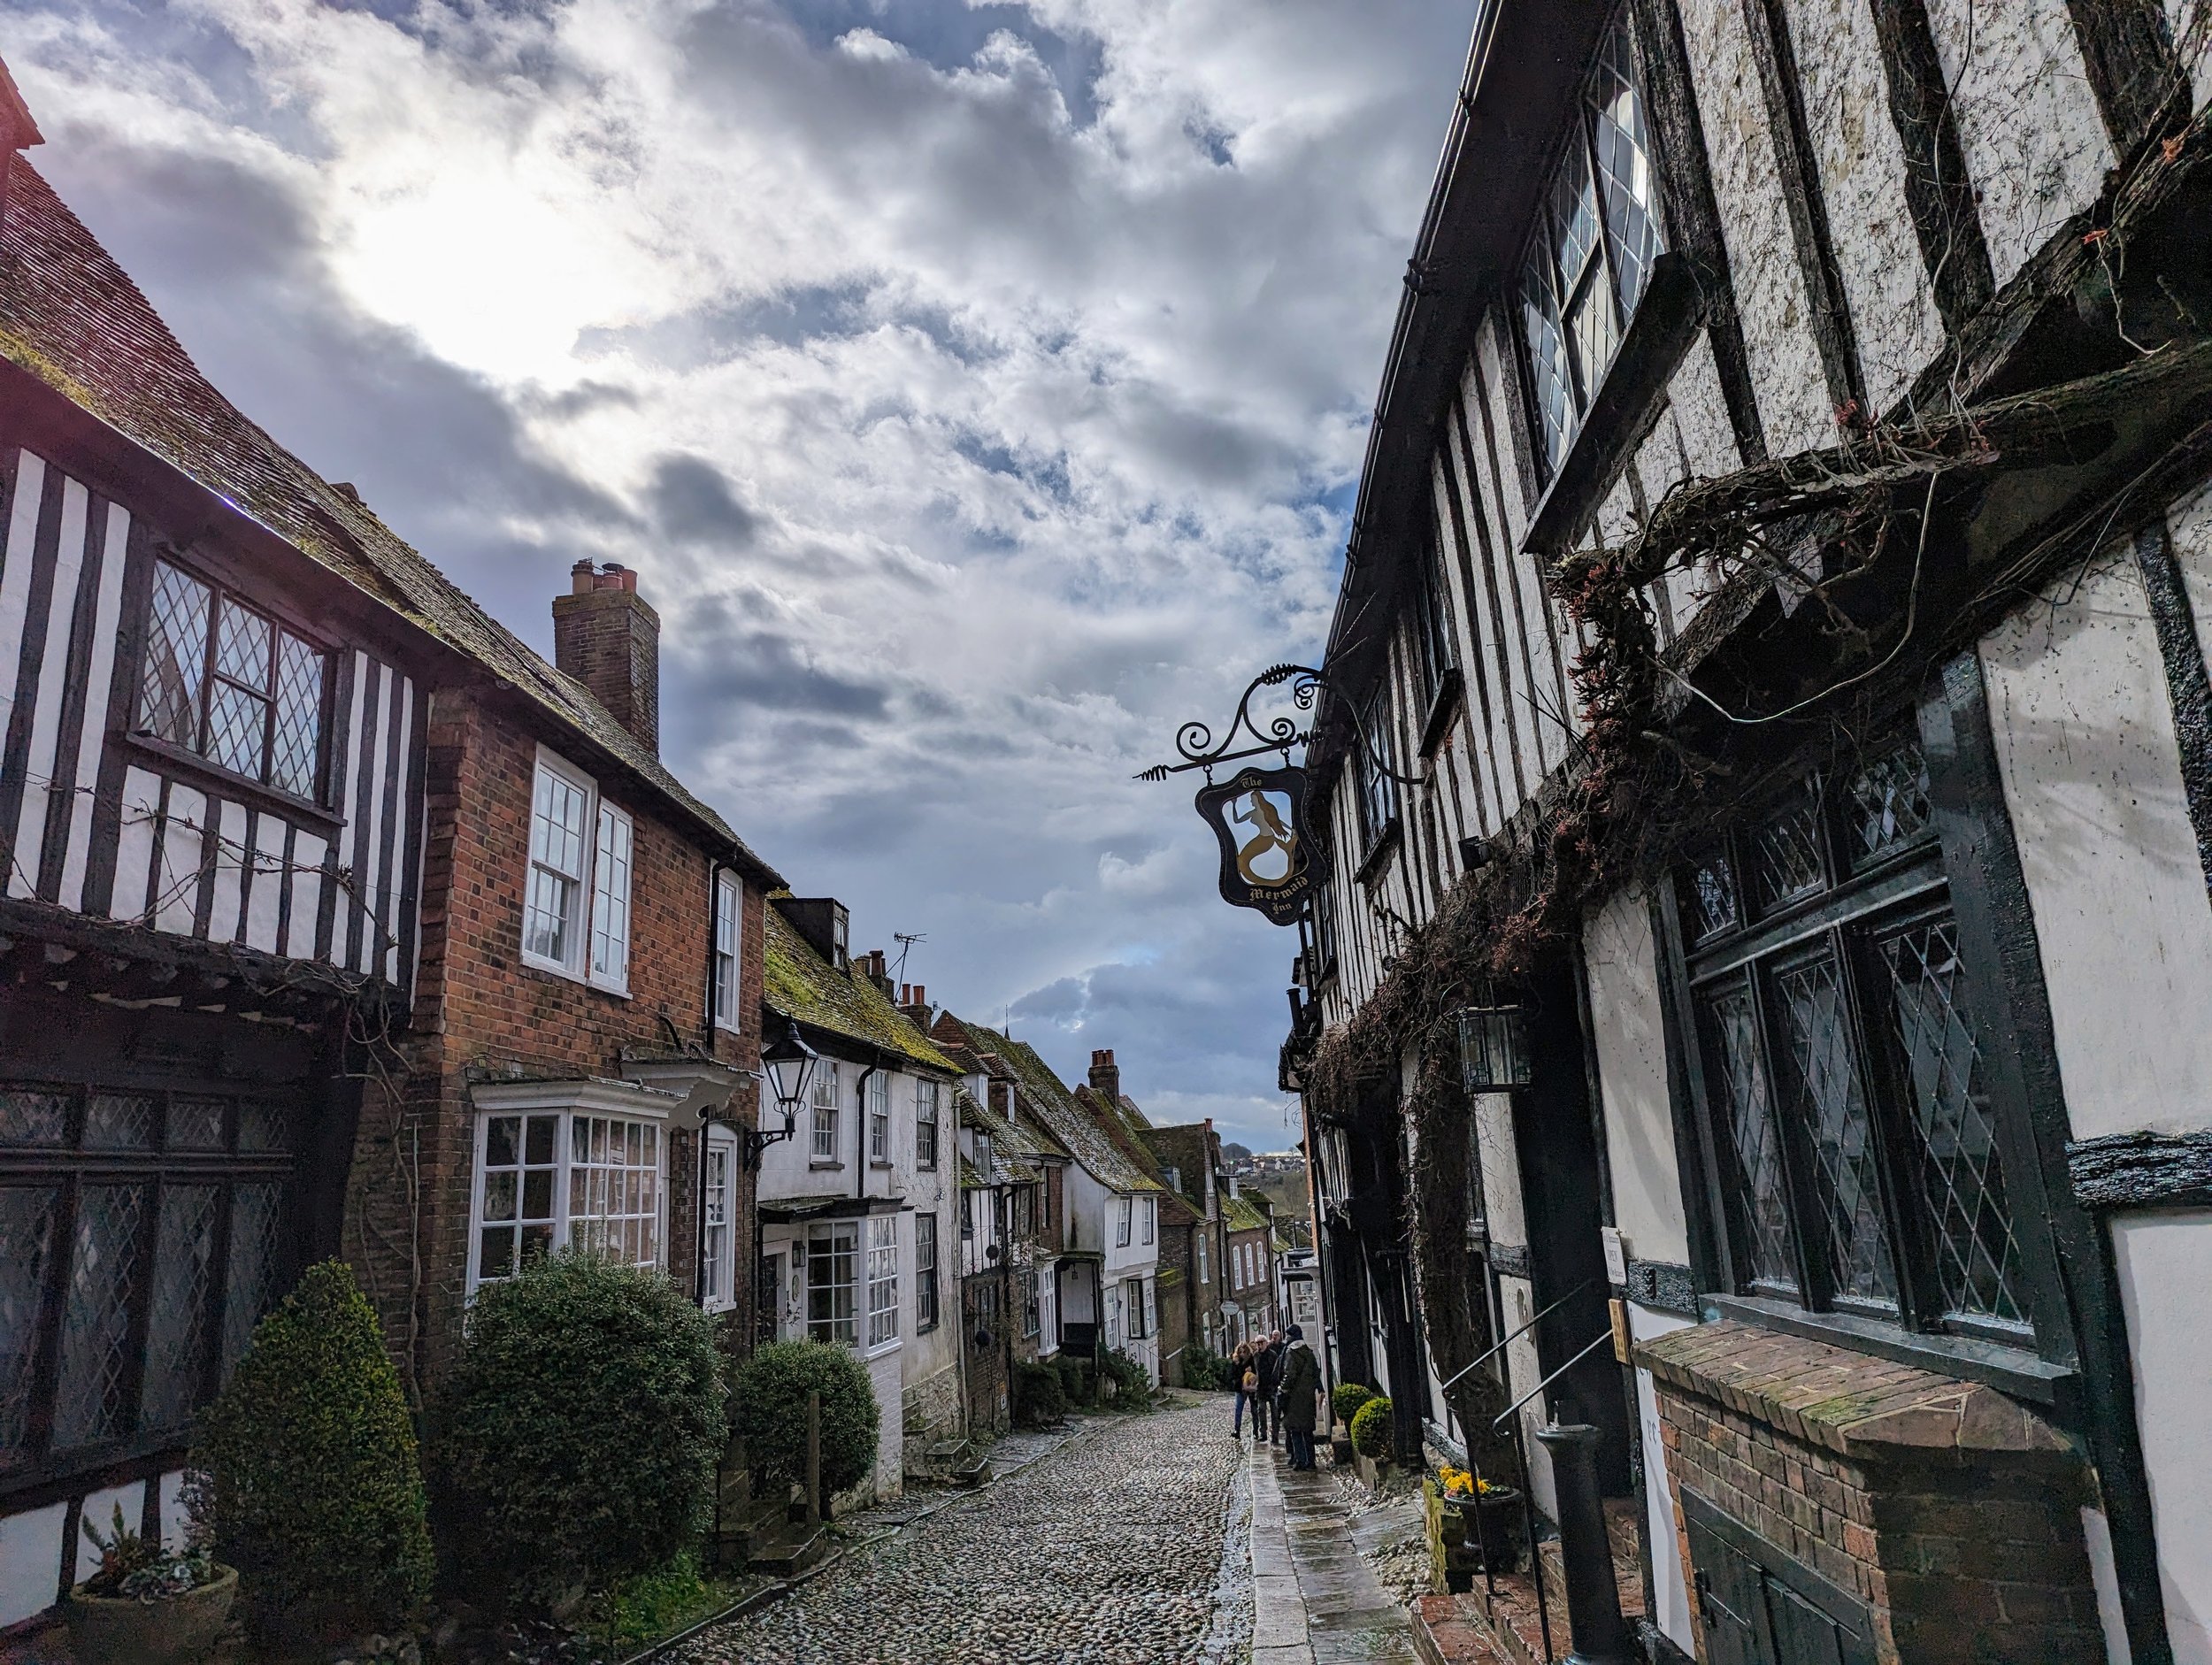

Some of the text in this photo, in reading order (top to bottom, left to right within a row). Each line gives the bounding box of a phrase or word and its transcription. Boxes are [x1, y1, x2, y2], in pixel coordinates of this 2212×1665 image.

[1240, 777, 1262, 788] The
[1249, 876, 1309, 901] Mermaid
[1272, 902, 1293, 916] Inn
